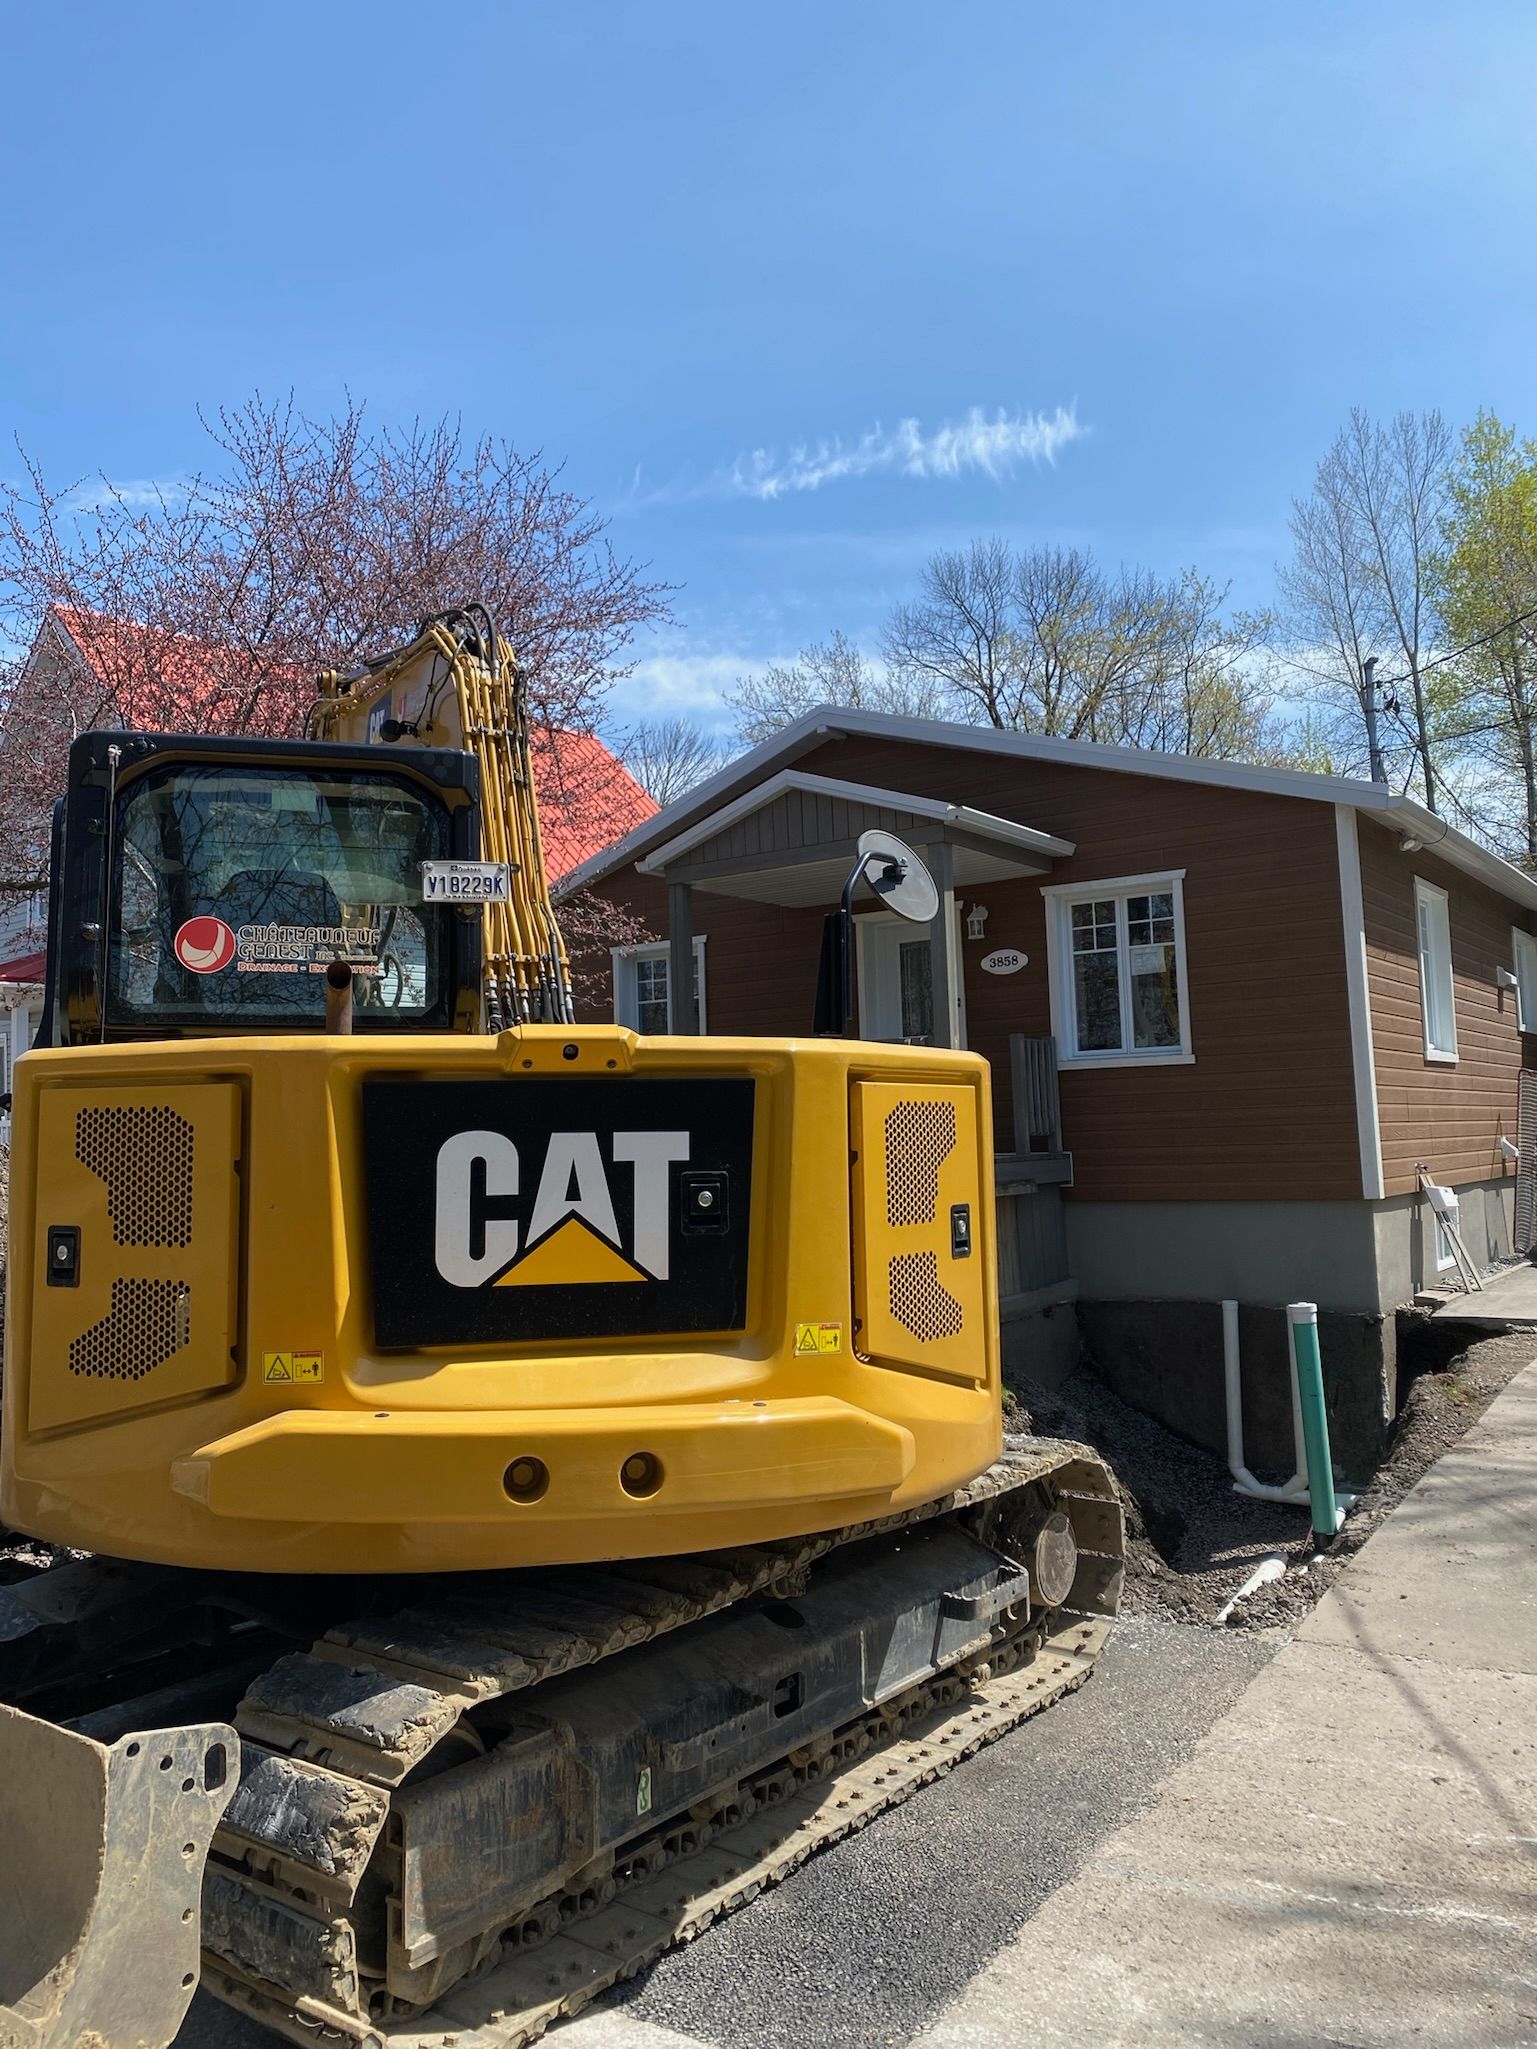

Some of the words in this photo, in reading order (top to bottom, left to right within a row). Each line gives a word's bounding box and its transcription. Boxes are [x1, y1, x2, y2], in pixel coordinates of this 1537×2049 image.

[428, 875, 504, 895] V18229K
[238, 942, 313, 962] GENEST
[989, 955, 1019, 968] 3858
[308, 962, 380, 975] EXTION
[435, 1130, 690, 1288] CAT
